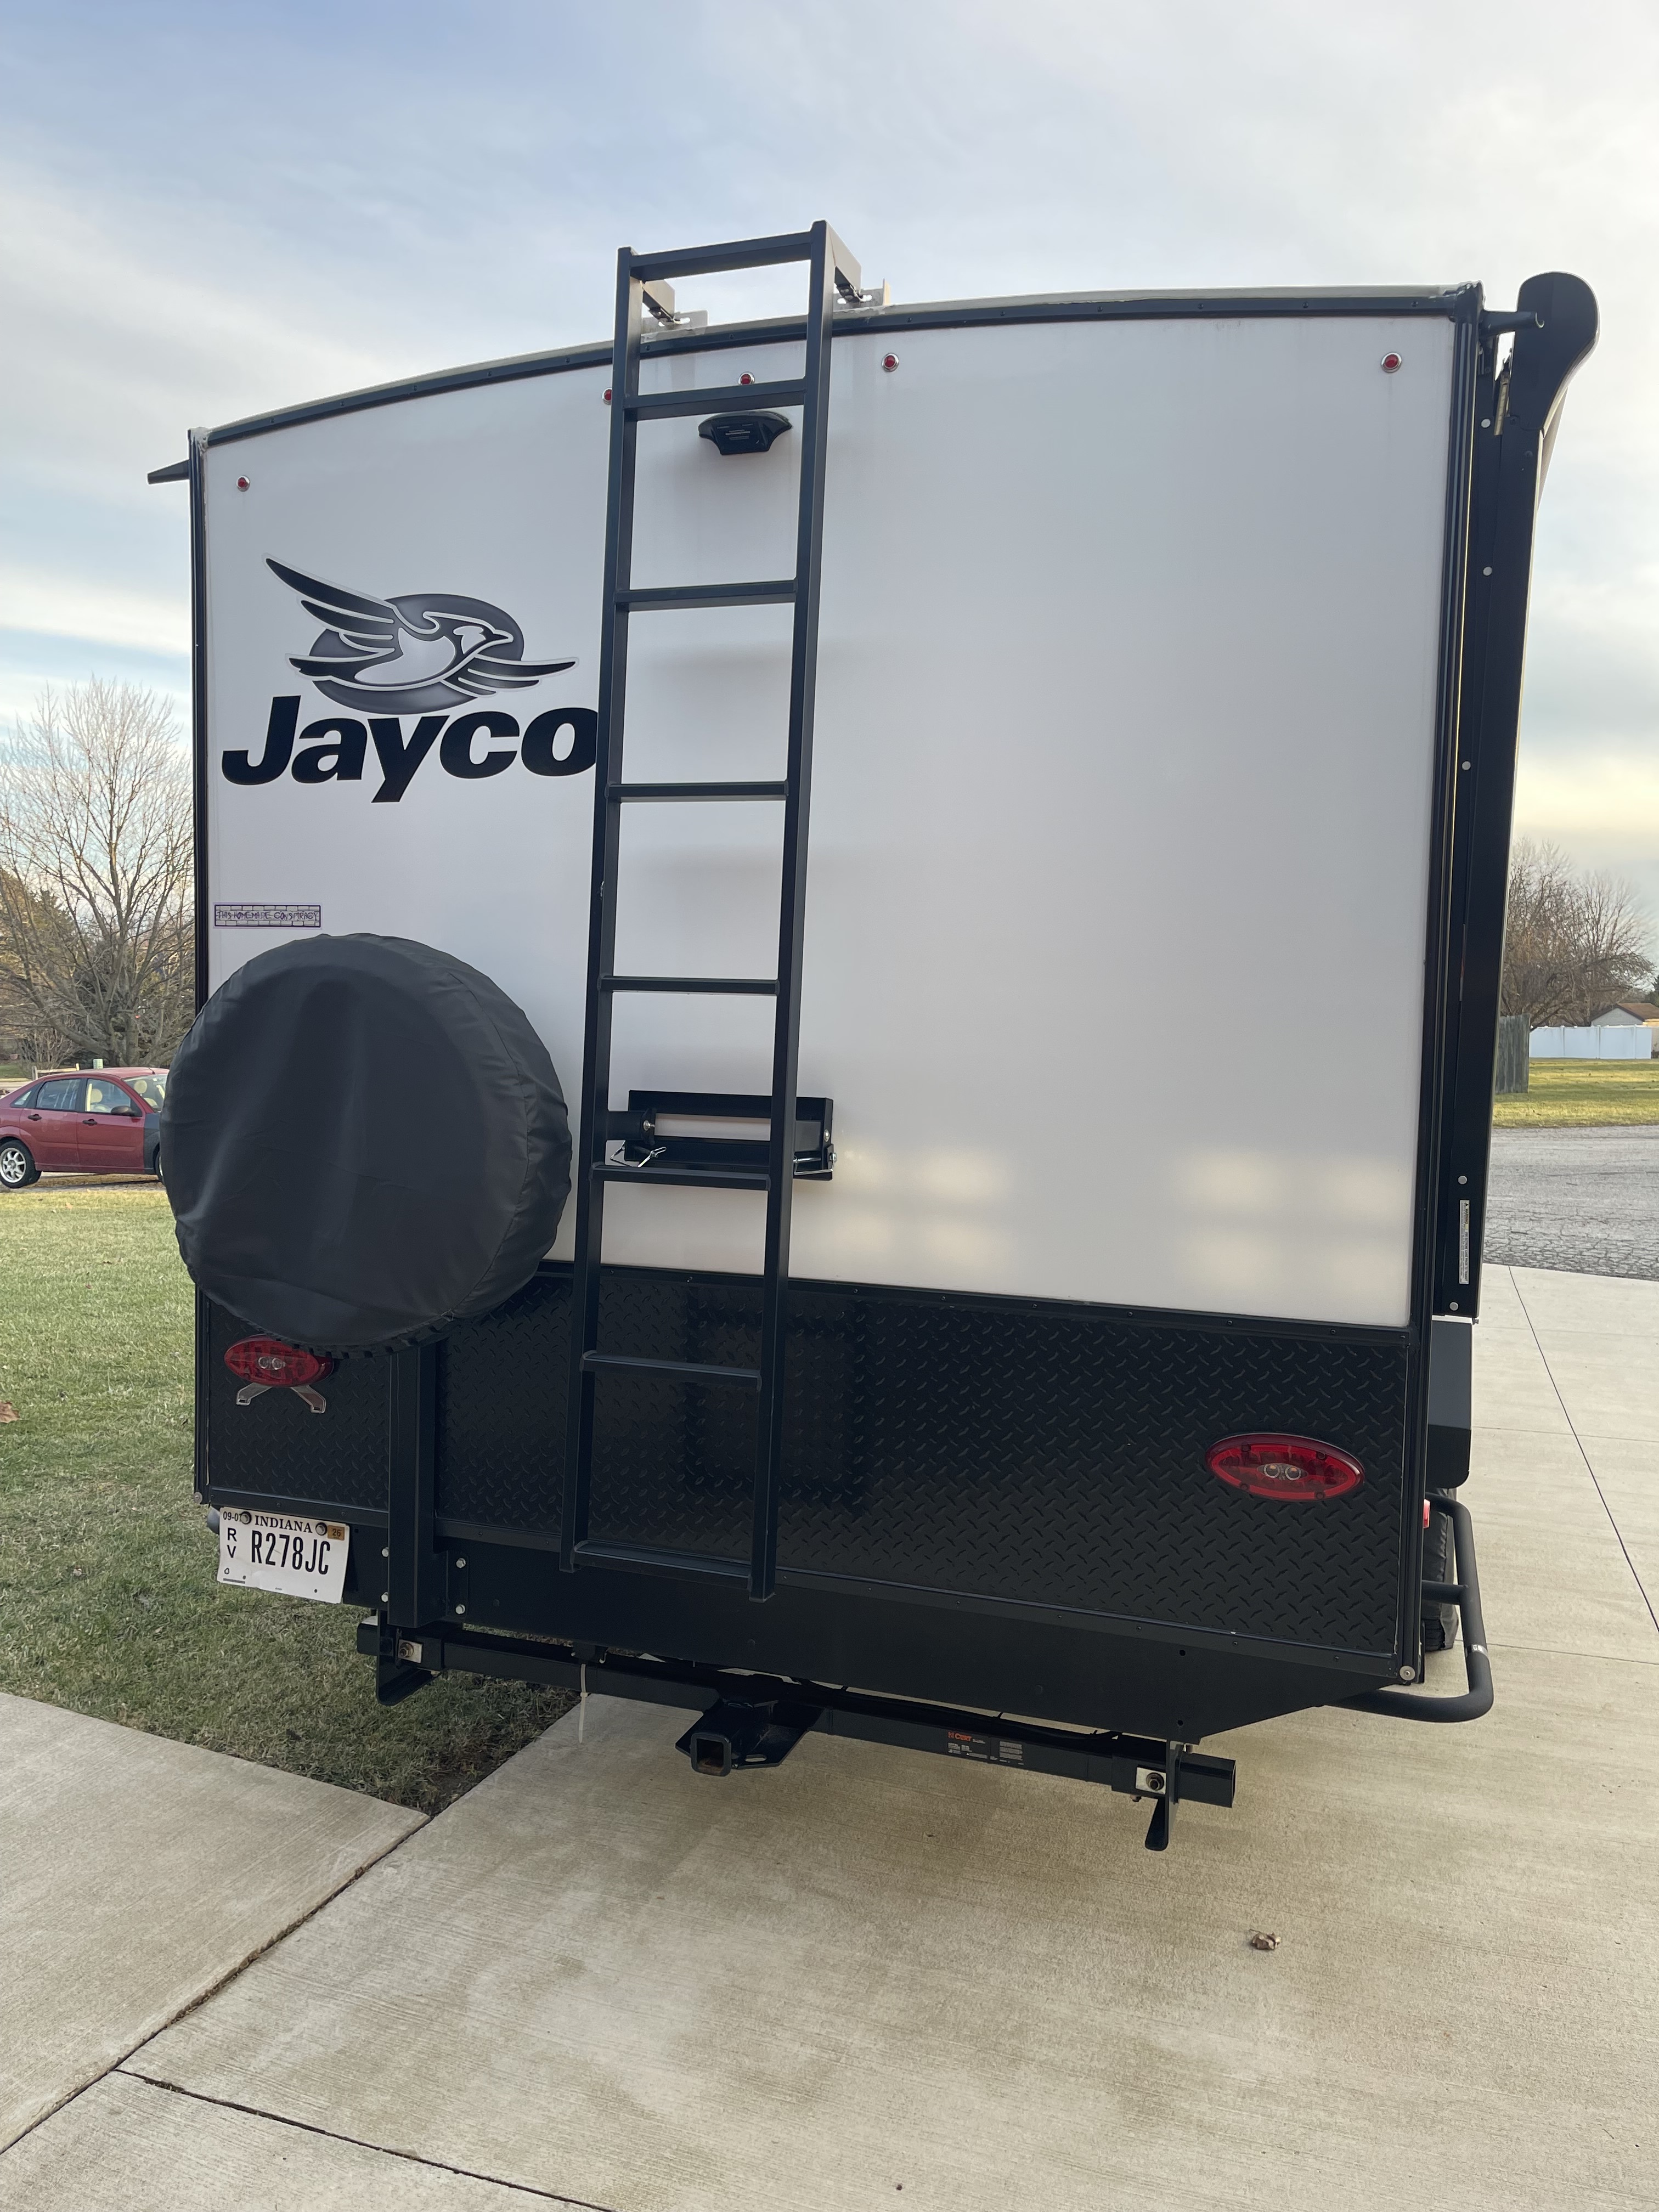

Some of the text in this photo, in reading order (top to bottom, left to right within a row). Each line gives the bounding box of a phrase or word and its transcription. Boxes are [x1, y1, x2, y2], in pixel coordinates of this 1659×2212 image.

[221, 695, 599, 803] Jayco
[217, 911, 232, 919] THIS
[255, 1515, 313, 1533] INDIANA
[332, 1528, 341, 1537] 26
[251, 1530, 330, 1575] R278JC
